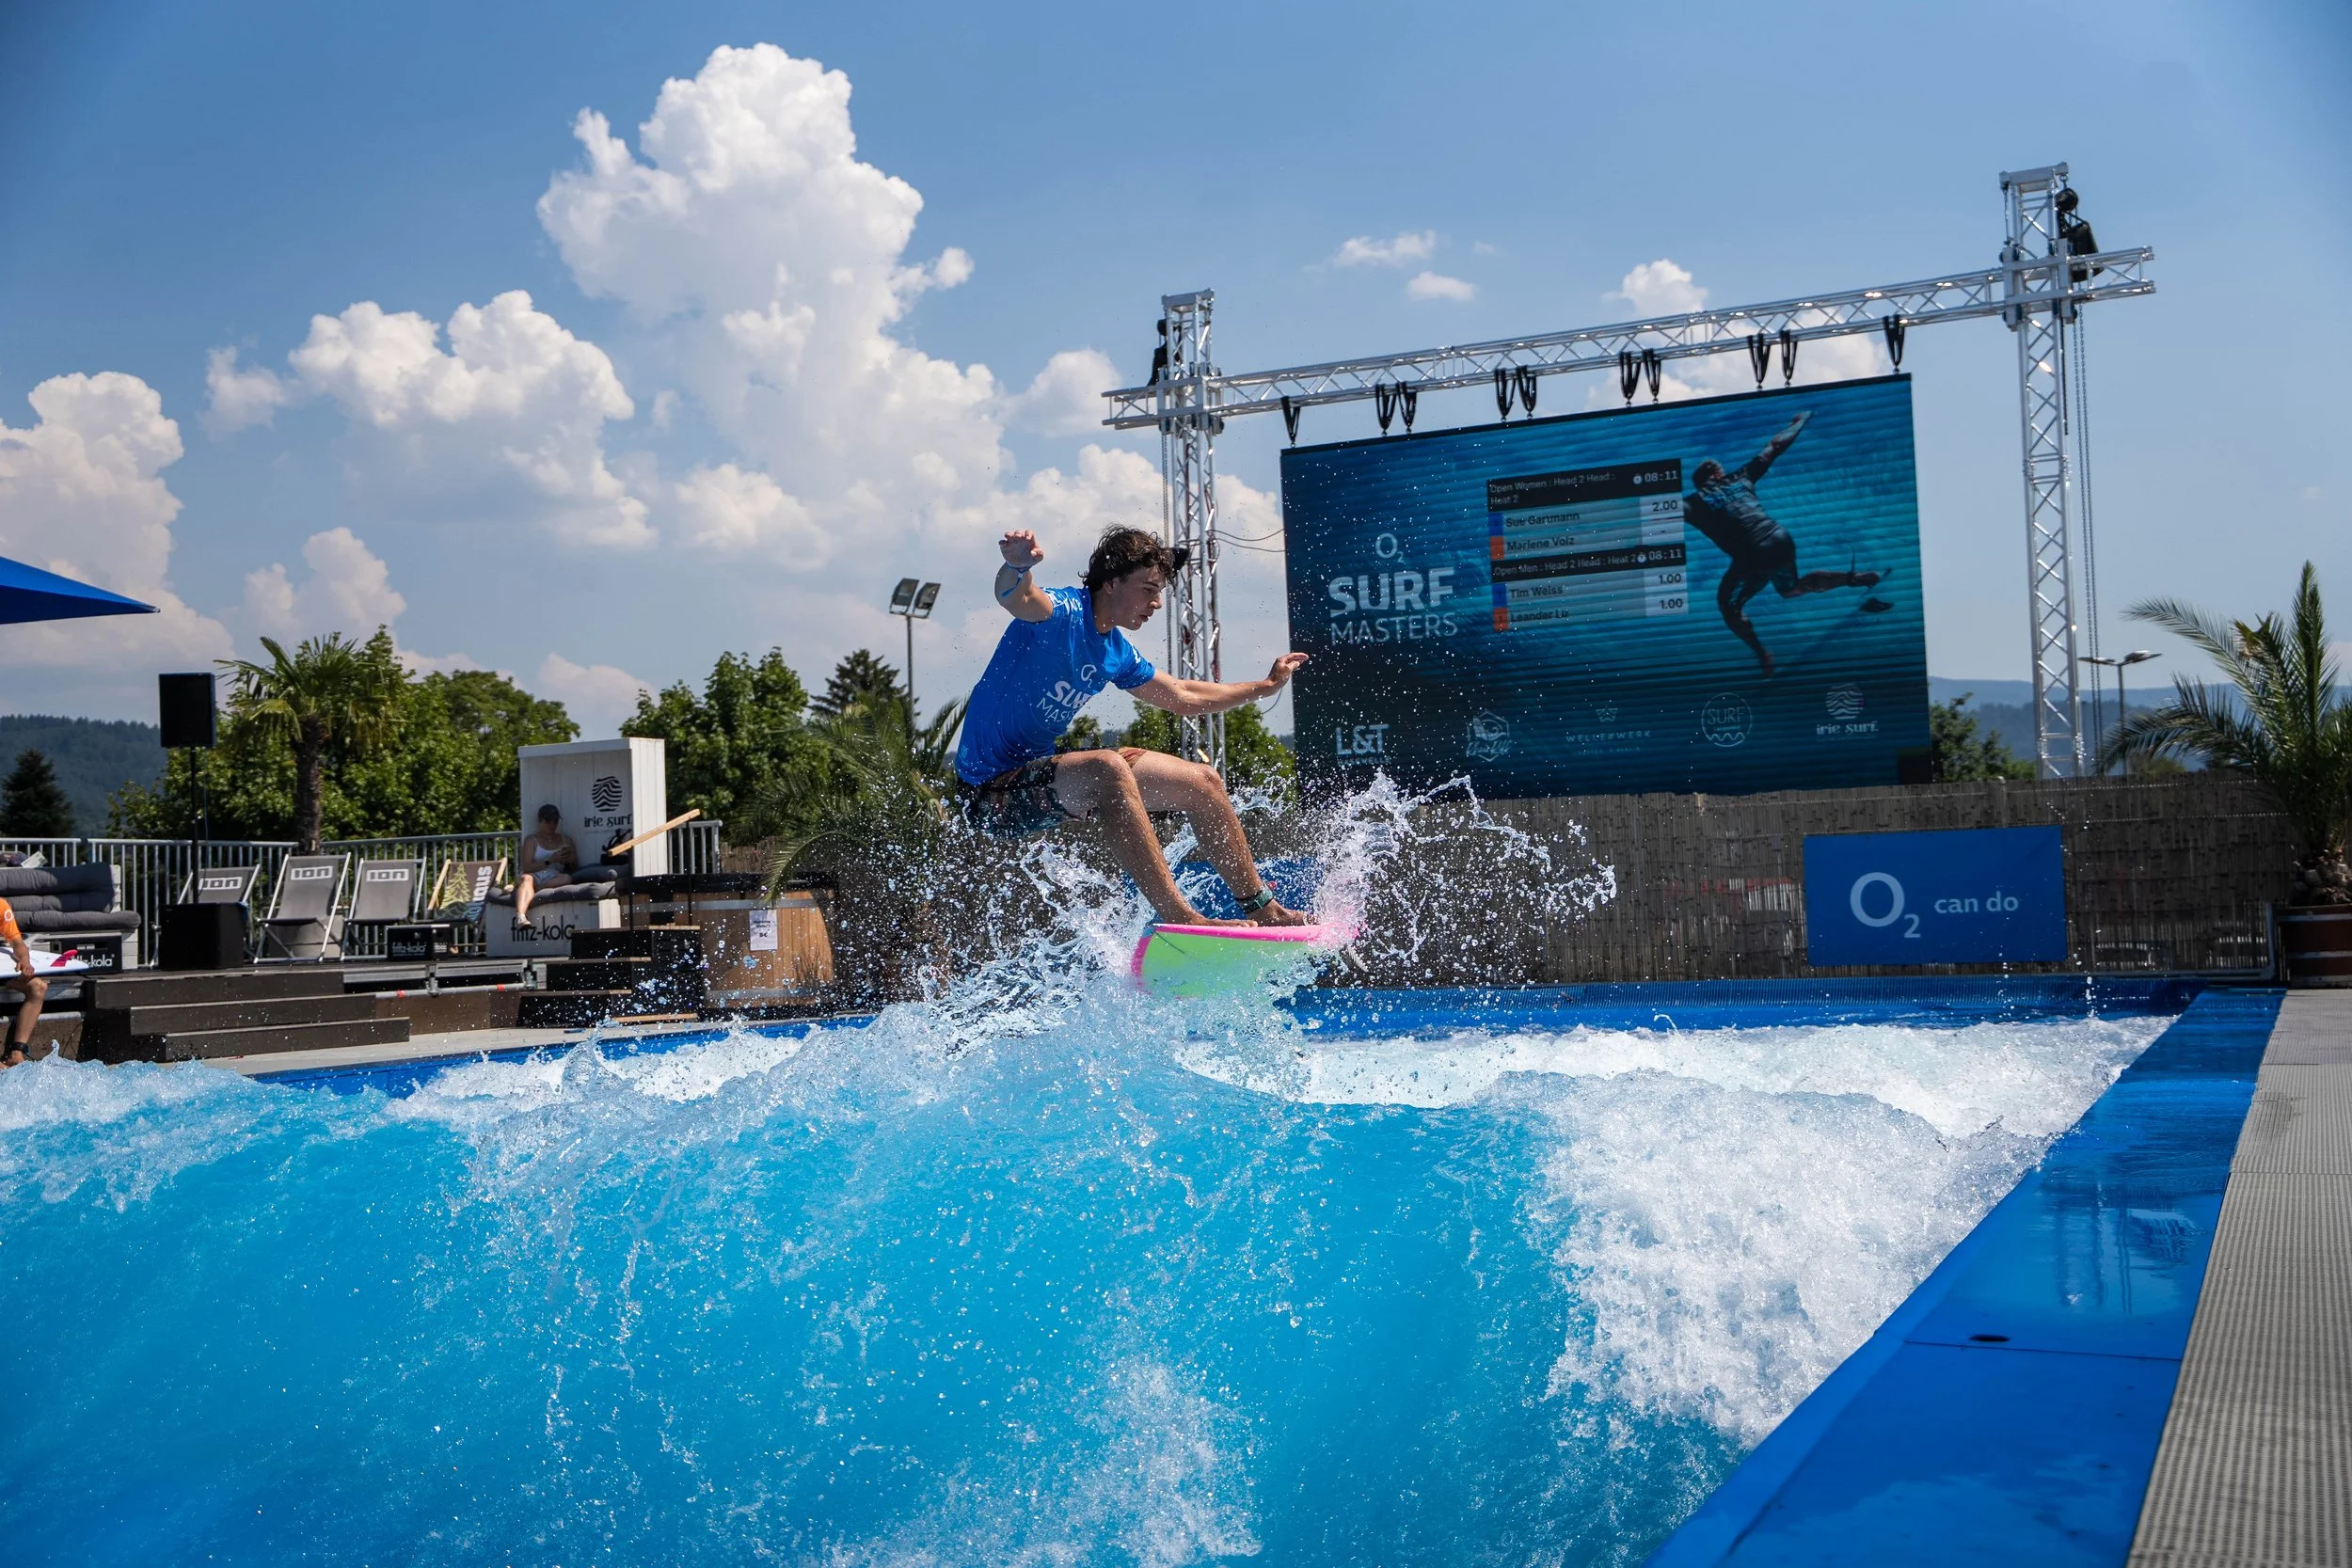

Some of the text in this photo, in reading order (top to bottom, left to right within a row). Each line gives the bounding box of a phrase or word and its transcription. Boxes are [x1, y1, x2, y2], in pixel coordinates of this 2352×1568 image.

[1489, 483, 1513, 494] Open
[1514, 480, 1548, 491] Women
[1553, 476, 1578, 486] Head
[1579, 475, 1585, 483] 2
[1586, 472, 1610, 483] Head
[1644, 470, 1678, 483] 08:11
[1490, 495, 1518, 505] Heat 2
[1652, 499, 1677, 513] 2.00
[1505, 516, 1528, 528] Sue
[1528, 513, 1581, 526] Gartmann
[1506, 535, 1575, 551] Marlene Volz
[1648, 548, 1682, 561] 08:11
[1494, 567, 1518, 577] Open
[1518, 564, 1539, 574] Men
[1544, 562, 1568, 572] Head
[1569, 560, 1576, 569] 2
[1577, 557, 1600, 568] Head
[1607, 555, 1629, 565] Heat
[1629, 554, 1636, 562] 2
[1658, 573, 1681, 585] 1.00
[1328, 567, 1454, 618] SURF
[1509, 588, 1532, 599] Tim
[1533, 585, 1564, 597] Weiss
[1660, 598, 1683, 610] 1.00
[1510, 610, 1552, 623] Leander
[1329, 612, 1458, 646] MASTERS
[1707, 705, 1746, 725] SURF
[1816, 723, 1841, 736] irie
[1335, 723, 1390, 755] L&T
[583, 816, 603, 828] irie
[1934, 896, 1979, 914] can
[1986, 891, 2019, 912] do
